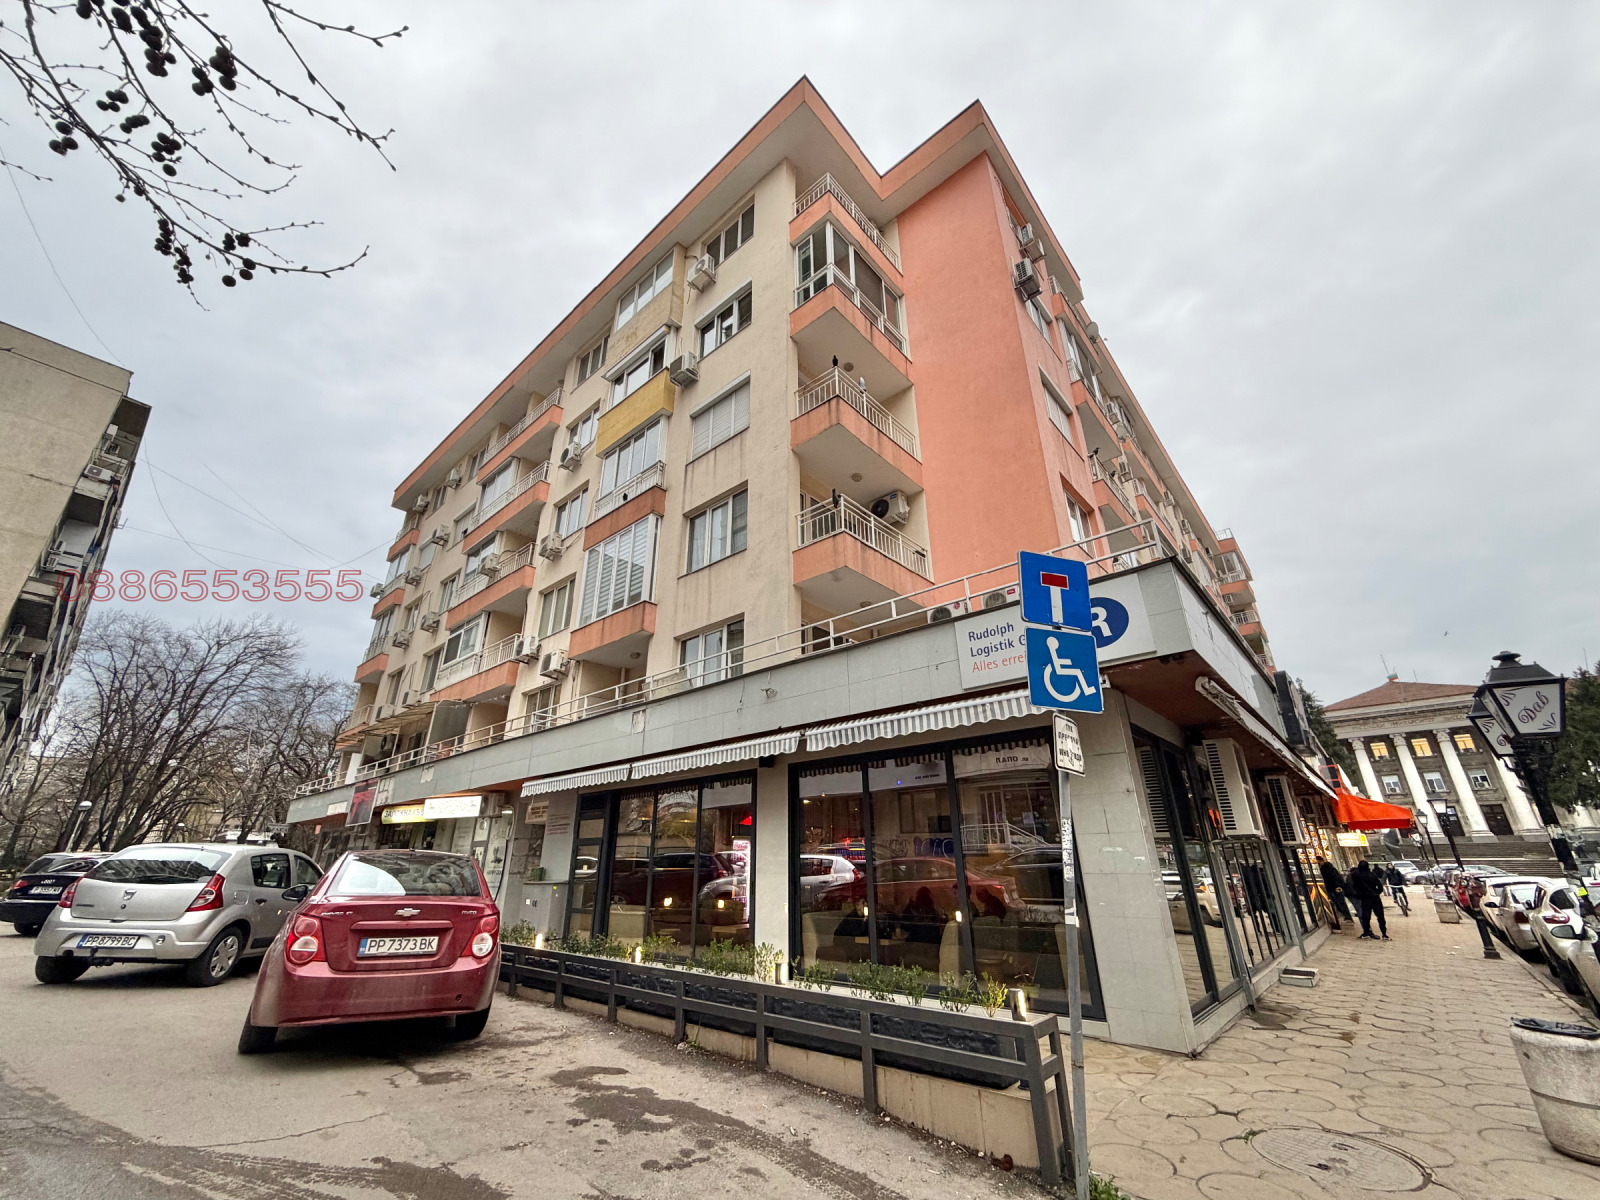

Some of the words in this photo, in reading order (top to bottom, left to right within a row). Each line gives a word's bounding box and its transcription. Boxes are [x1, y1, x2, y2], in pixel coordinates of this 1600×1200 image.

[968, 621, 1014, 642] Rudolph
[970, 638, 1015, 657] Logistik
[1018, 634, 1026, 646] G
[972, 660, 999, 673] Alles
[98, 936, 123, 946] 8799
[367, 939, 386, 952] PP
[387, 938, 418, 952] 7373
[418, 937, 436, 950] BK
